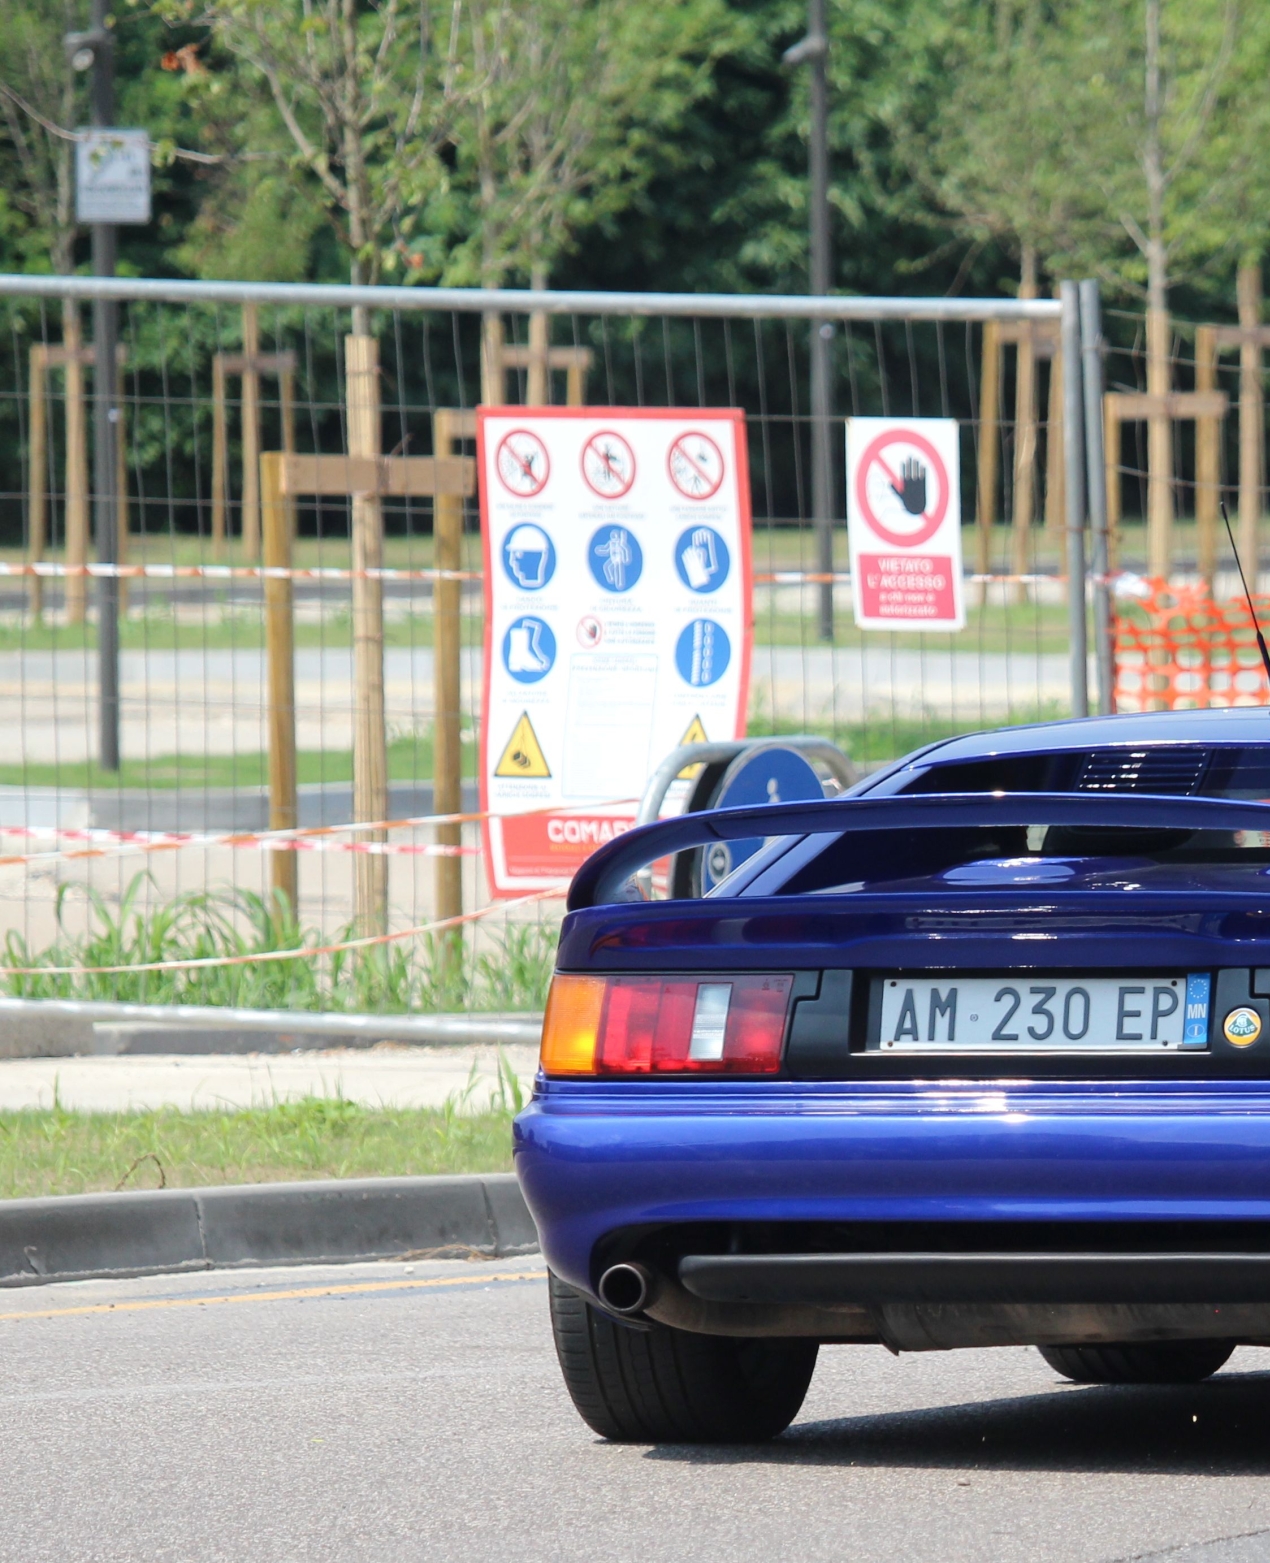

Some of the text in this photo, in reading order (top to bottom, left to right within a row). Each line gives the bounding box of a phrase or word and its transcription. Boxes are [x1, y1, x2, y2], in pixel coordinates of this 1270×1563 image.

[878, 558, 934, 574] VIETATO
[893, 986, 1179, 1042] AM 230 EP
[1187, 1003, 1206, 1019] MN
[1228, 1024, 1257, 1034] LOTUS
